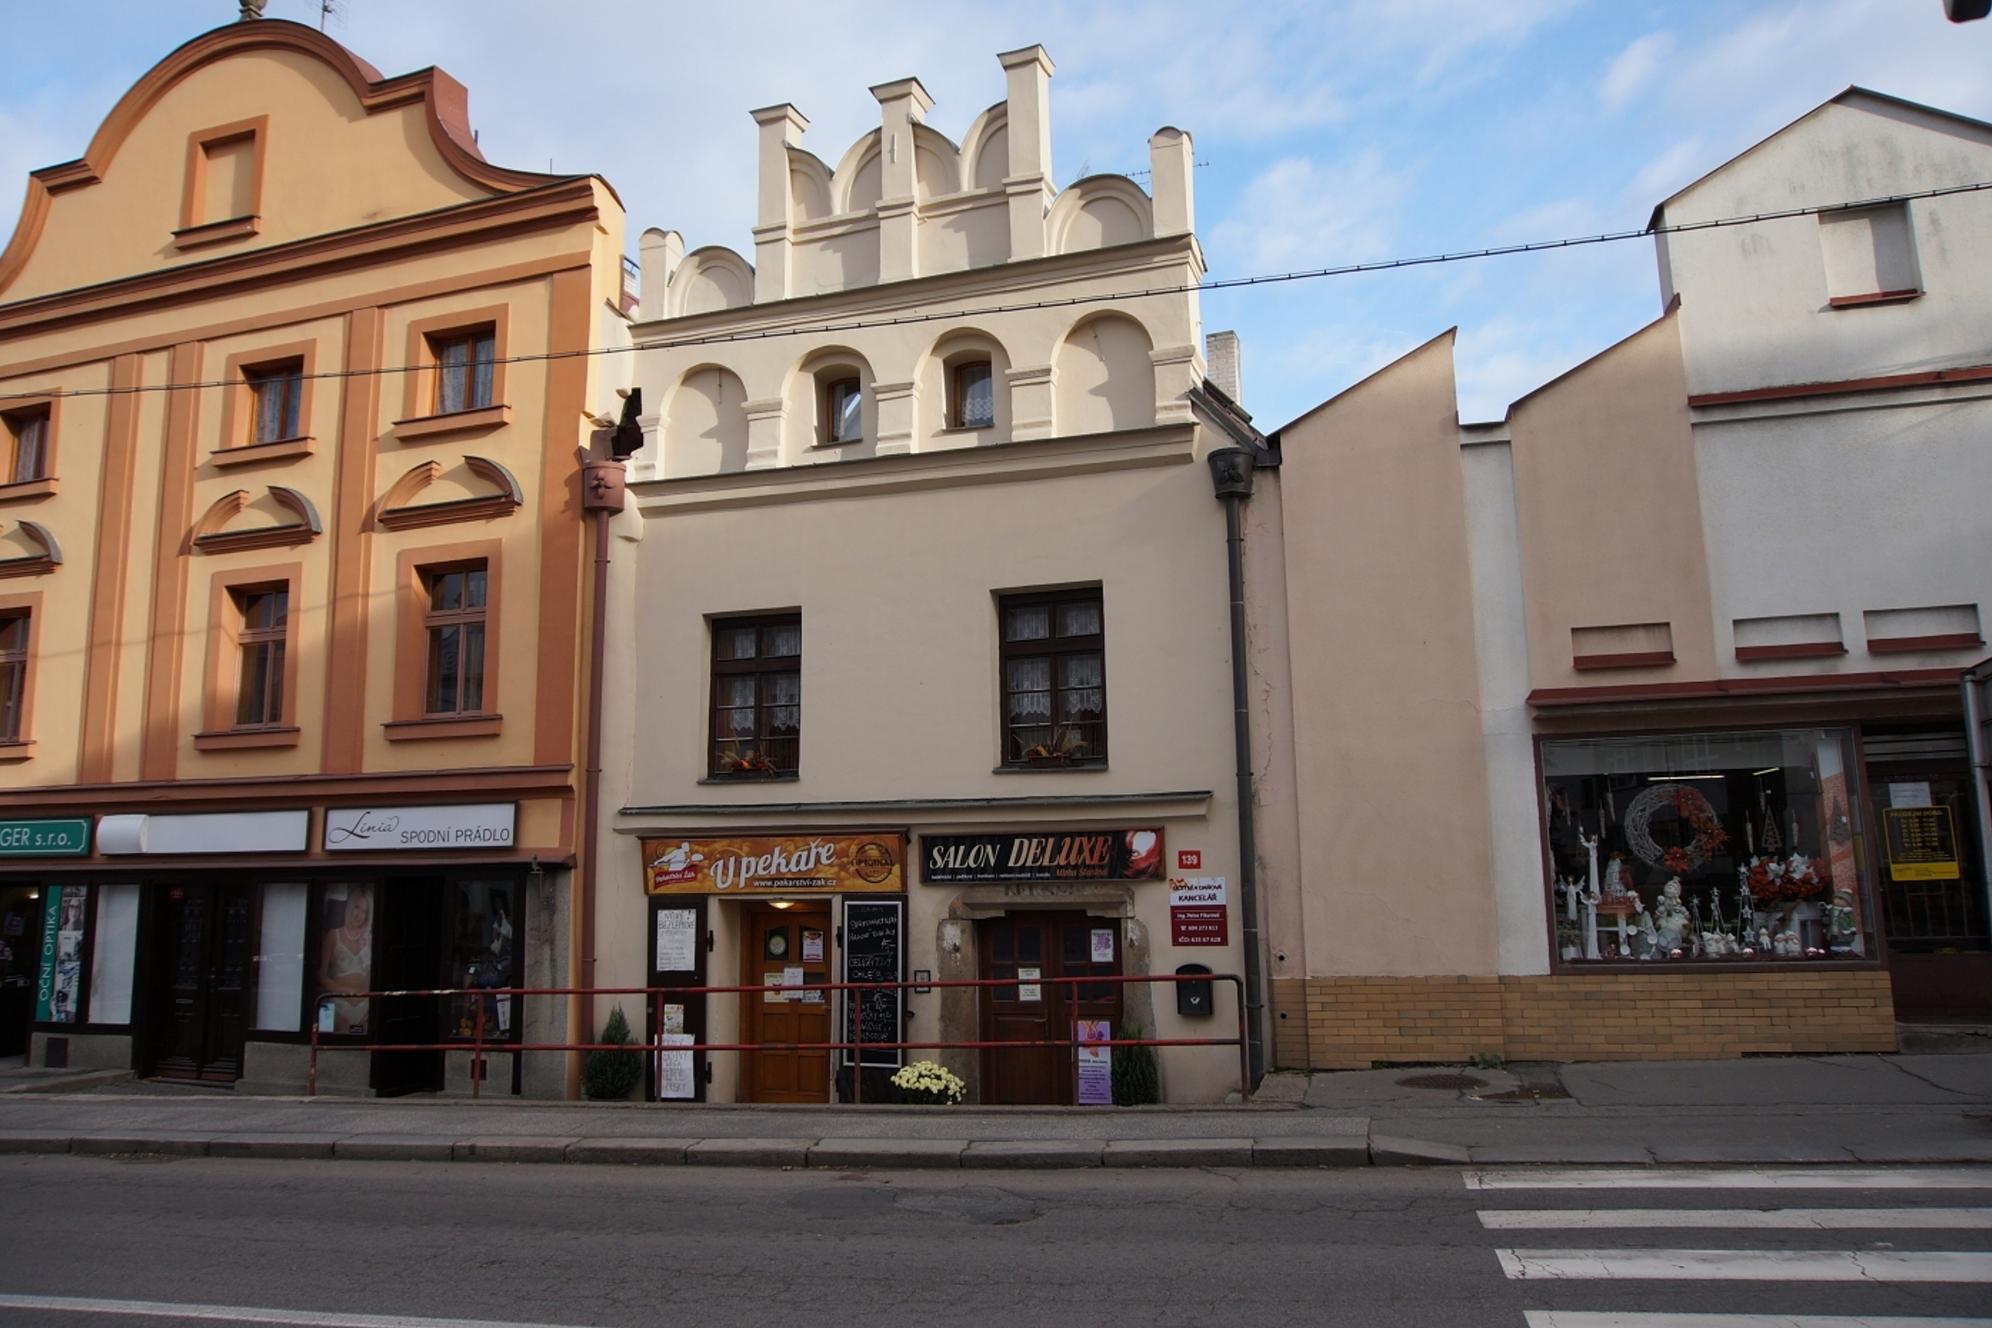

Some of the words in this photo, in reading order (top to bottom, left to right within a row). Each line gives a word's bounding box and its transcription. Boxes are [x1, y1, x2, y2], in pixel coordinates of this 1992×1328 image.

[35, 833, 71, 846] s.r.o.
[400, 827, 452, 844] SPODNÍ
[456, 825, 511, 842] PRÁDLO
[710, 857, 736, 890] U
[739, 838, 837, 888] pekaře
[929, 843, 1001, 870] SALON
[1008, 835, 1113, 867] DELUXE
[1178, 893, 1217, 902] KANCELÁŘ
[43, 905, 57, 956] OPTIKA
[38, 962, 53, 1001] OČNÍ
